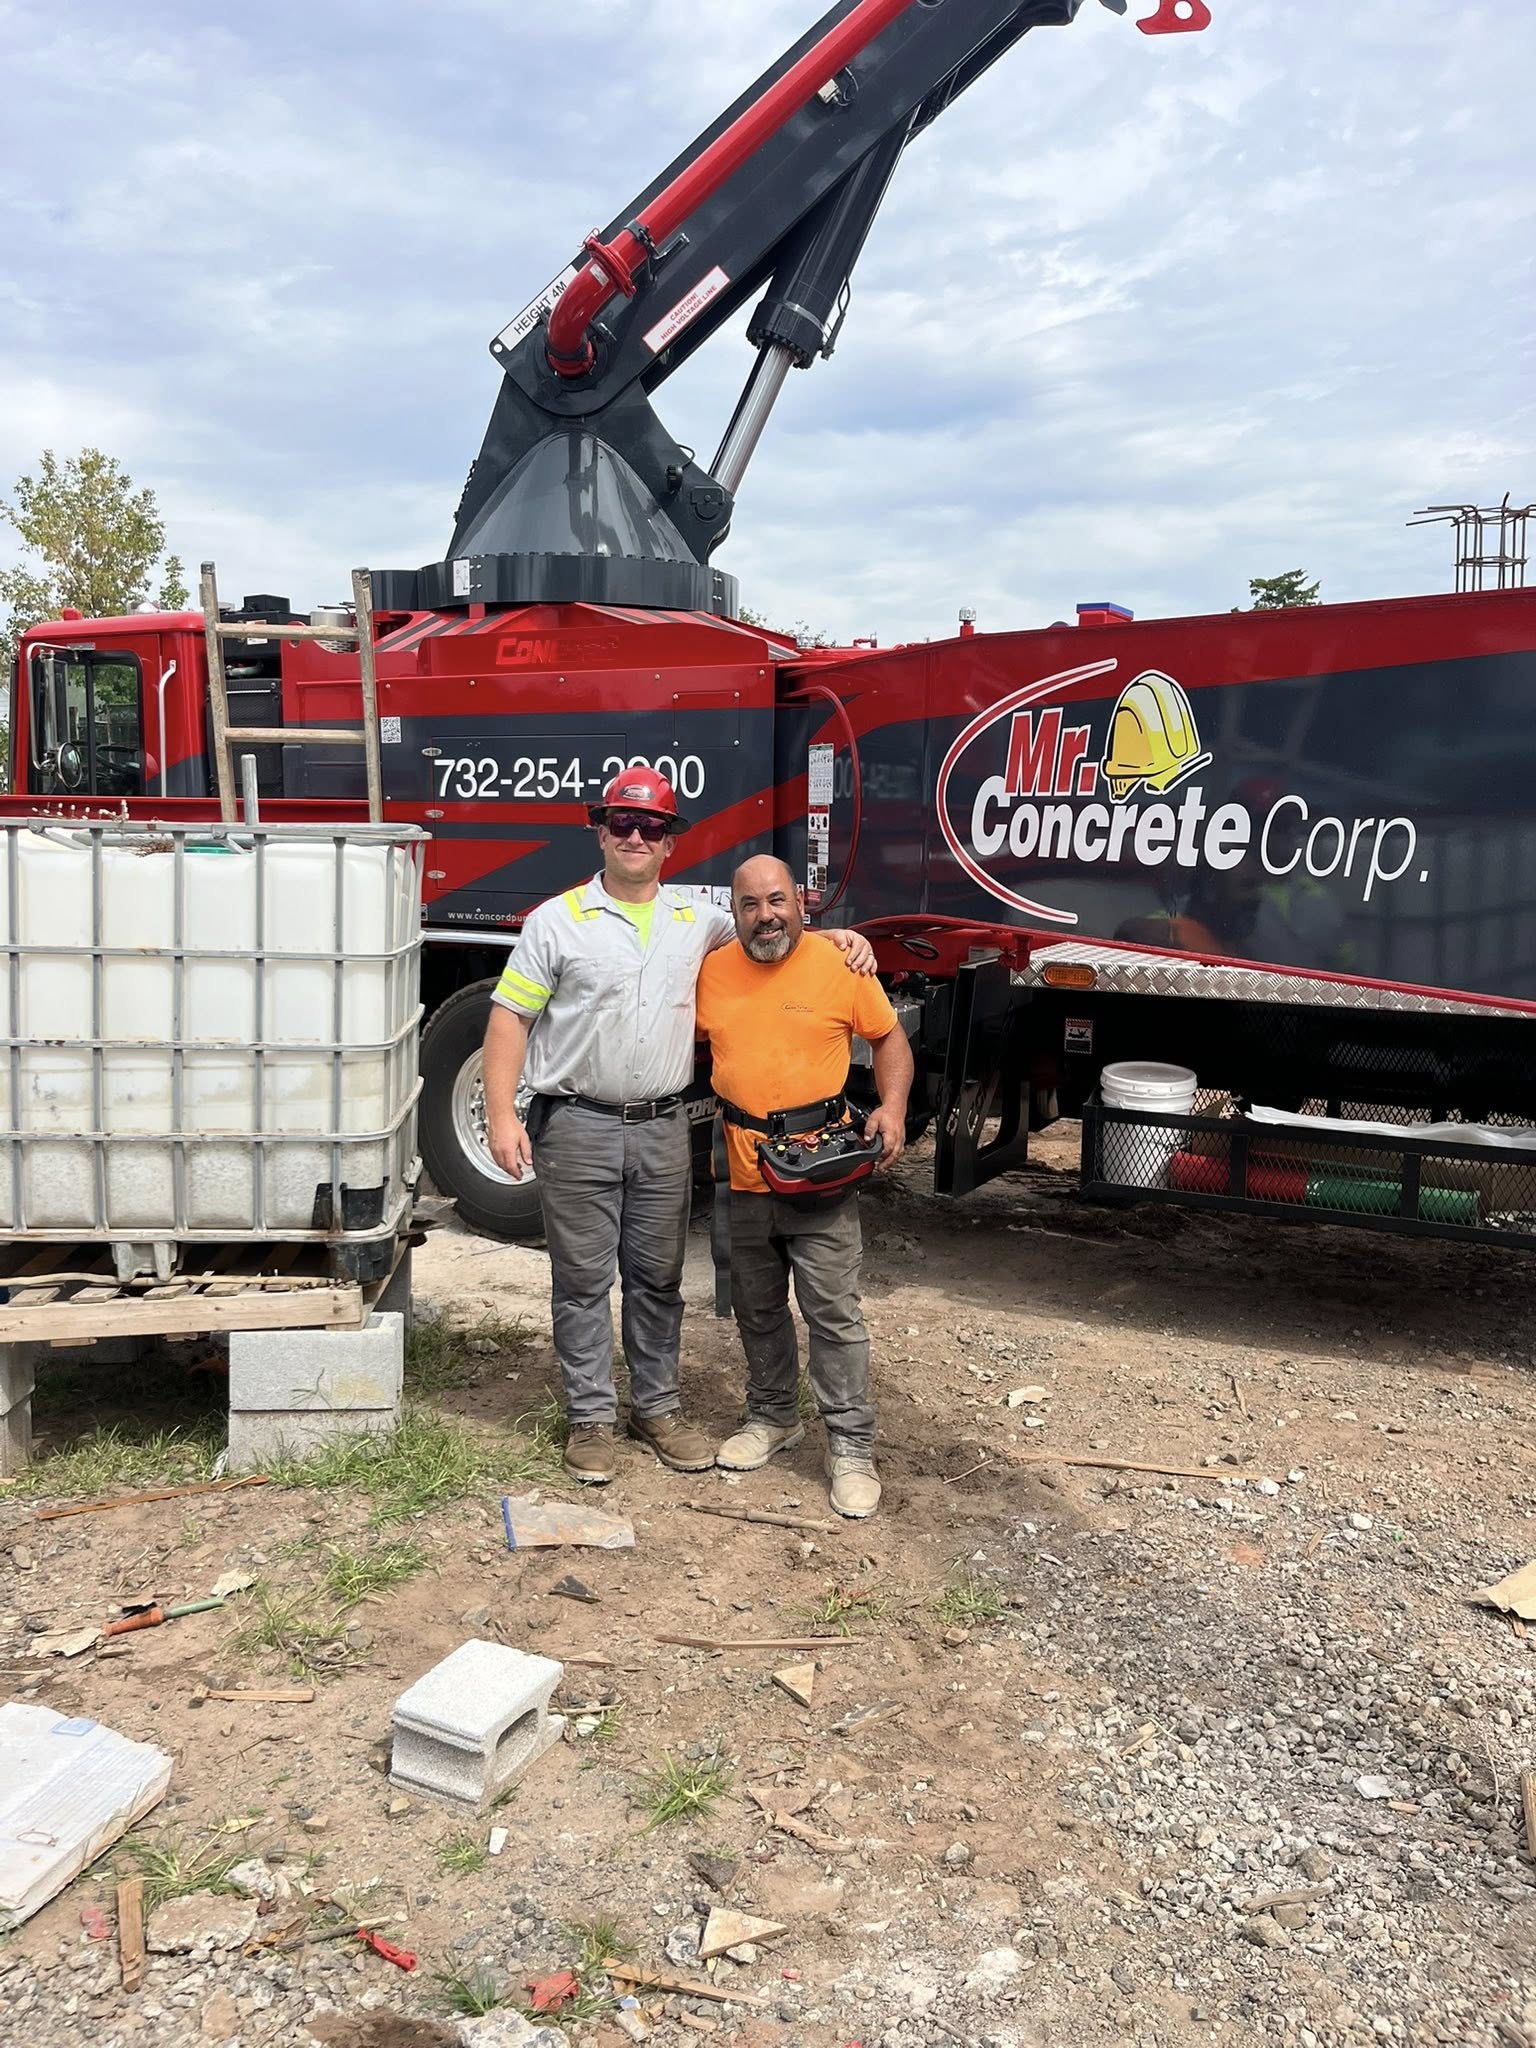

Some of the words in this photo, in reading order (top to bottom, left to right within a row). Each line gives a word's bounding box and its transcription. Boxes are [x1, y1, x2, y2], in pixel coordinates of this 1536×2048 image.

[513, 295, 552, 335] HEIGHT
[552, 281, 567, 298] 4M
[661, 324, 677, 340] HIGH
[677, 299, 704, 325] VOLTAGE
[702, 285, 717, 300] LINE
[434, 755, 705, 799] 732-254-200
[1004, 706, 1099, 797] Mr.
[971, 776, 1252, 870] Concrete
[1260, 794, 1430, 902] Corp.
